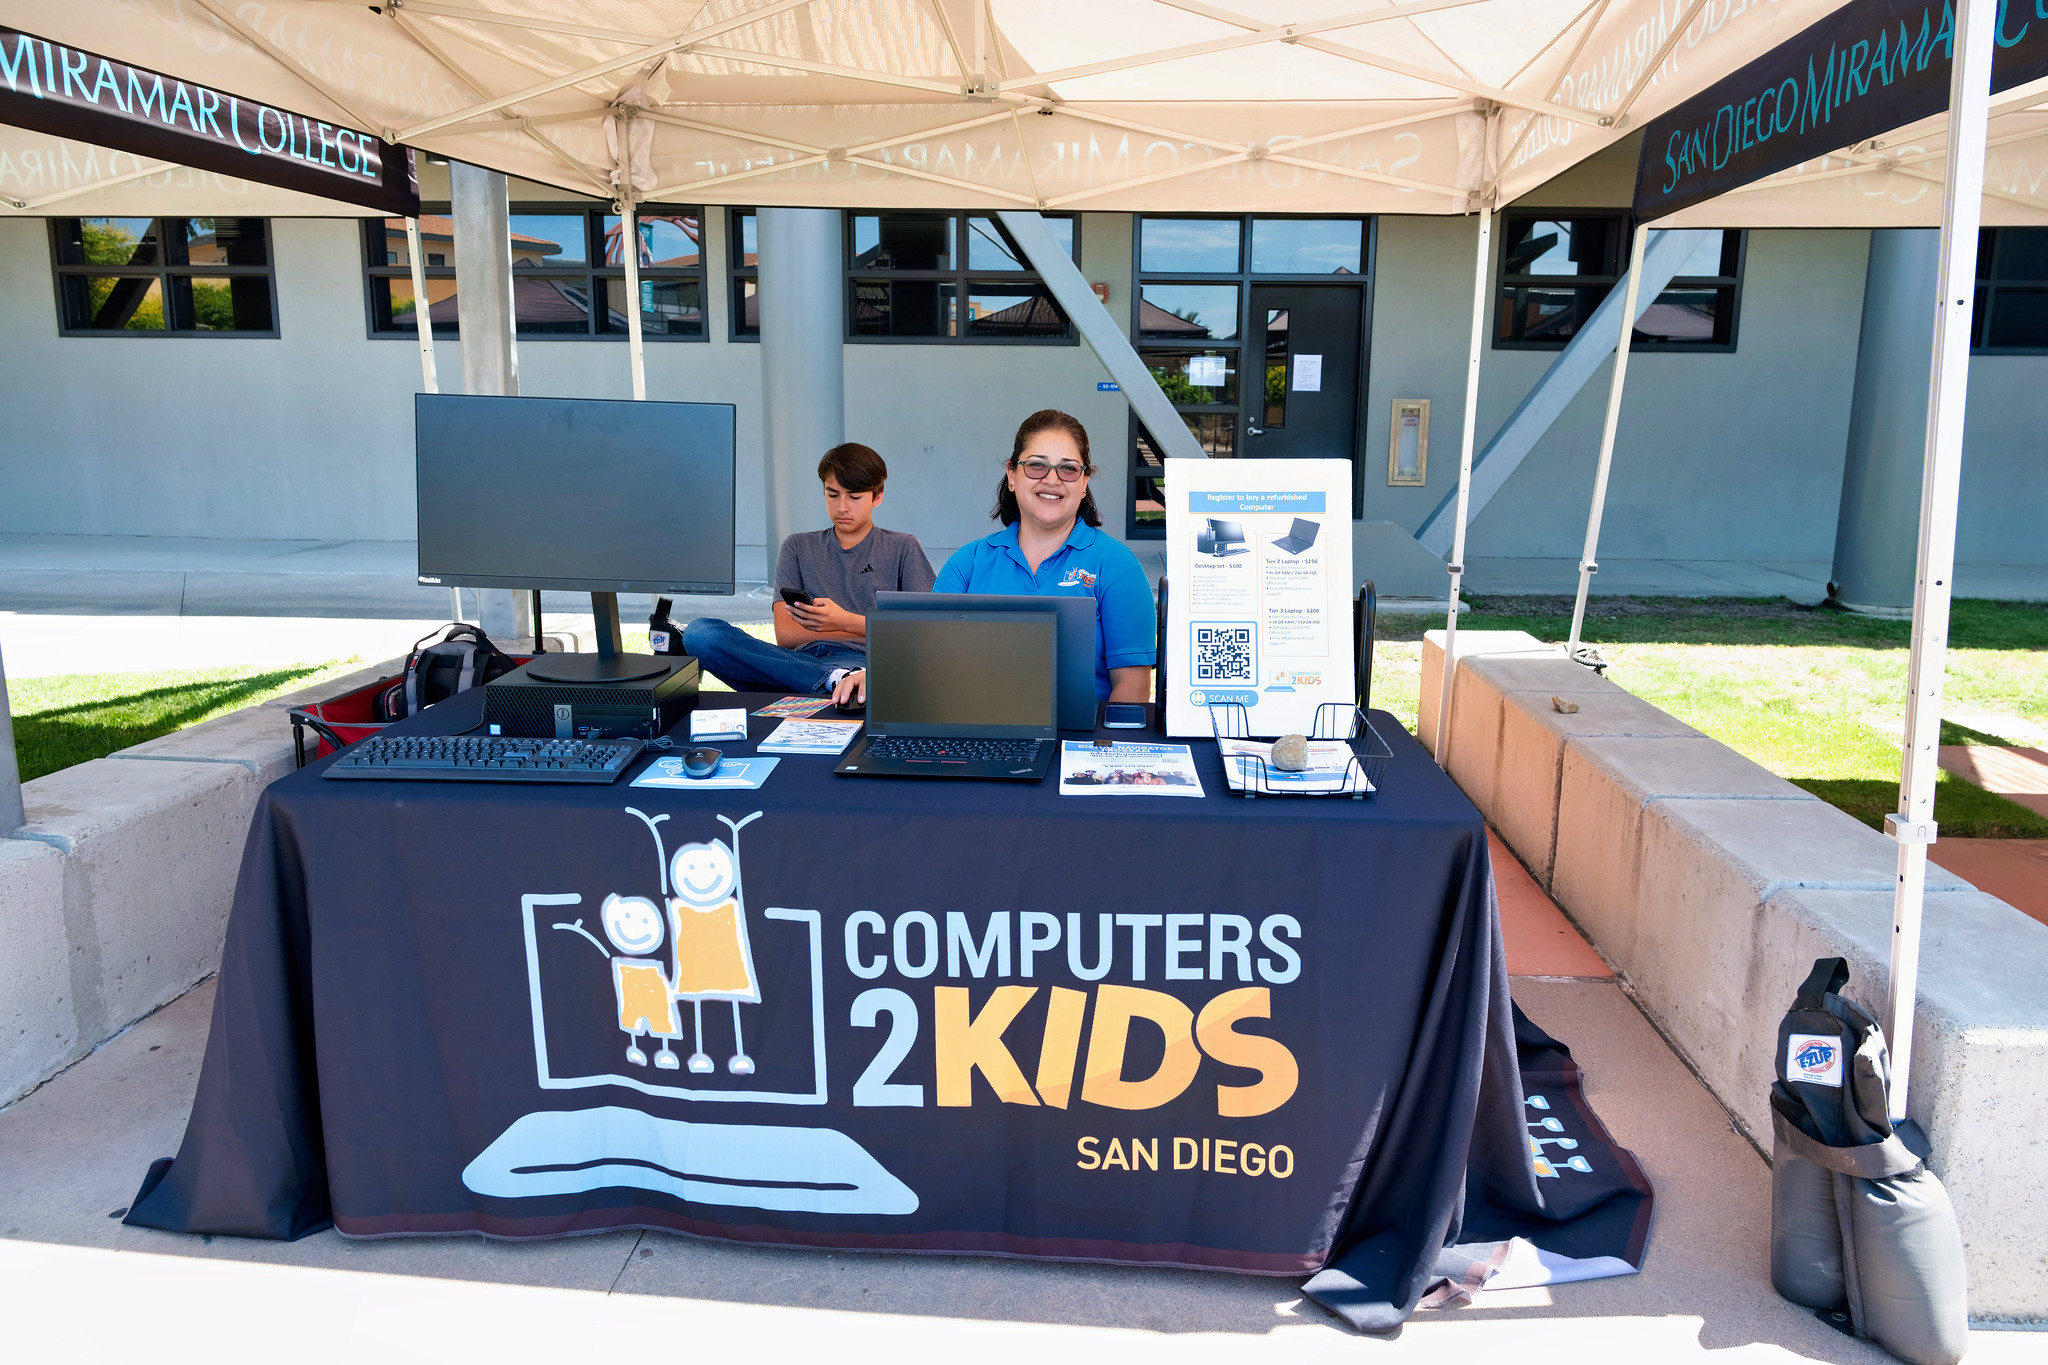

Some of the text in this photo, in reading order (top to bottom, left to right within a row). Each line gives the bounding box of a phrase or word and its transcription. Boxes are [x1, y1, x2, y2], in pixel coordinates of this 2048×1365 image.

[0, 34, 225, 139] MIRAMAR
[230, 96, 376, 178] COLLEGE
[1663, 122, 1710, 194] SAN
[1712, 77, 1799, 172] DIEGO
[1799, 0, 1954, 135] MIRAMA
[1207, 494, 1236, 502] Register
[1246, 494, 1259, 502] buy
[1209, 695, 1233, 703] SCAN
[1291, 676, 1322, 685] 2KIDS
[844, 910, 1302, 984] COMPUTERS
[849, 984, 1299, 1118] 2KIDS
[1076, 1136, 1294, 1179] SAN DIEGO
